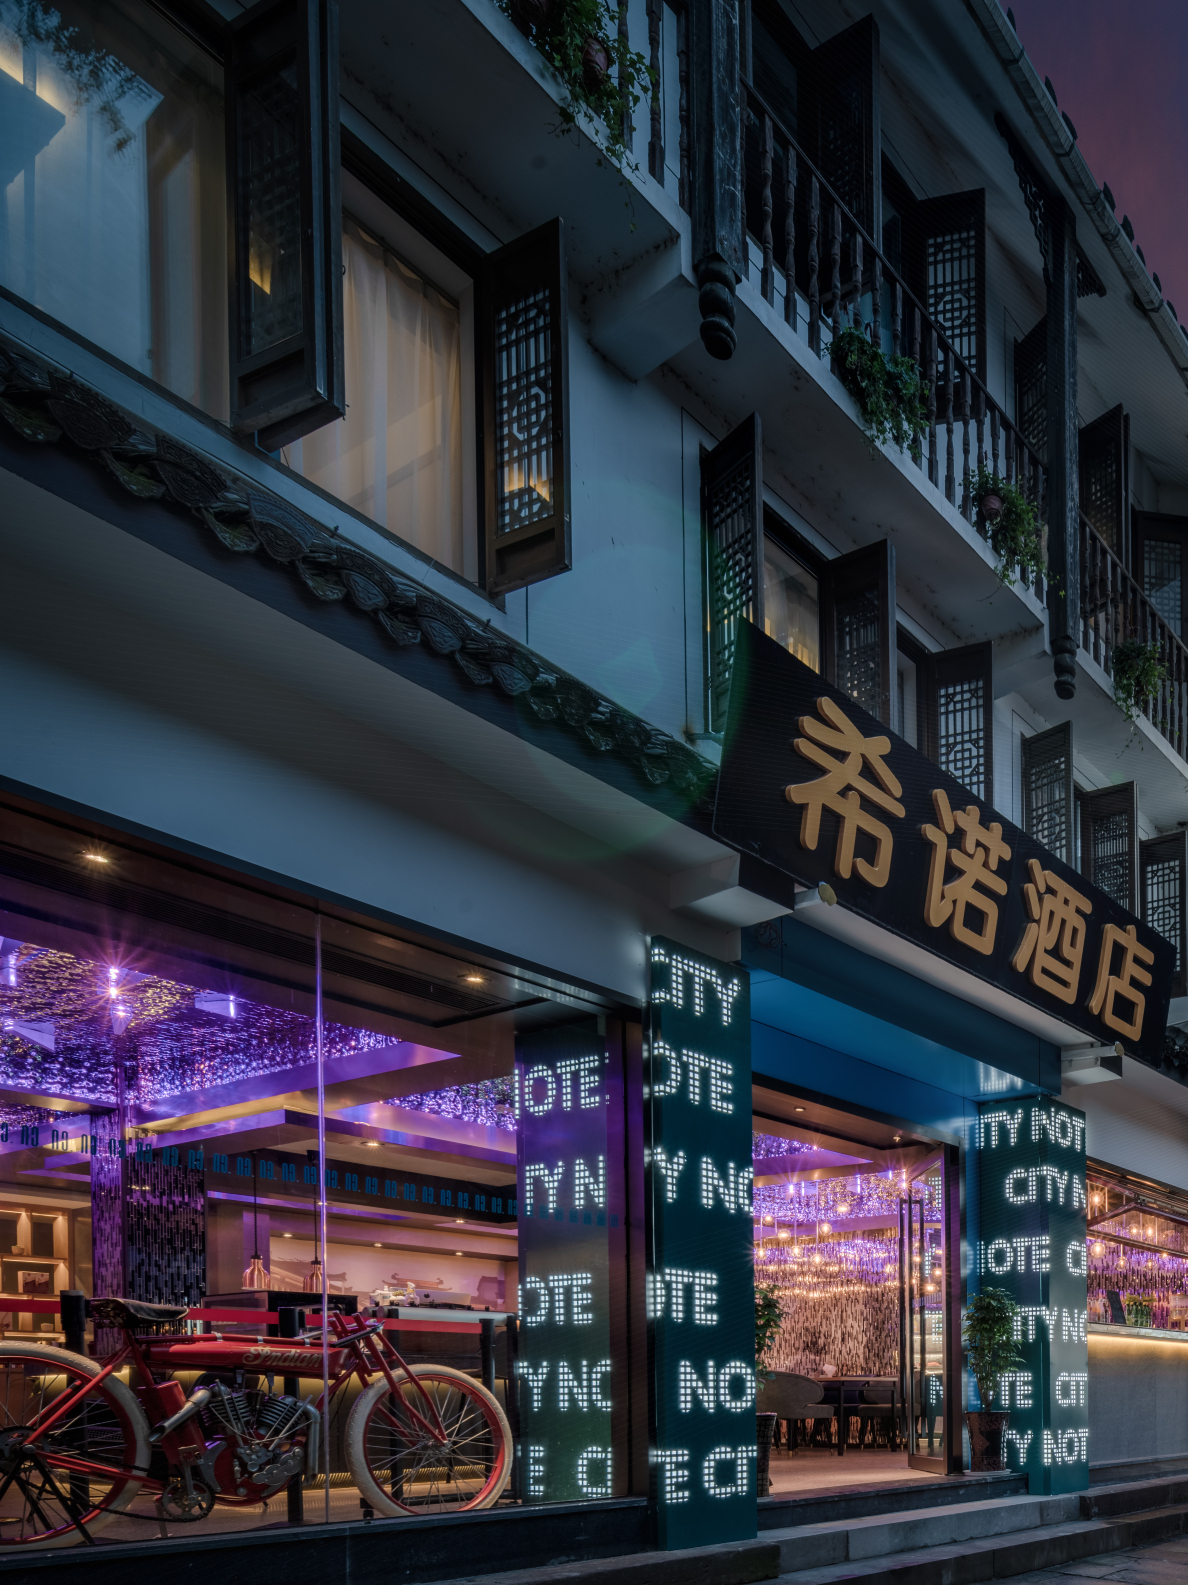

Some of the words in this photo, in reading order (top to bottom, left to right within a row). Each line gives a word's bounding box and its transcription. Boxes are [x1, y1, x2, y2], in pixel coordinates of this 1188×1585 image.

[786, 696, 1154, 1041] 希诺酒店
[242, 1345, 322, 1367] Indian
